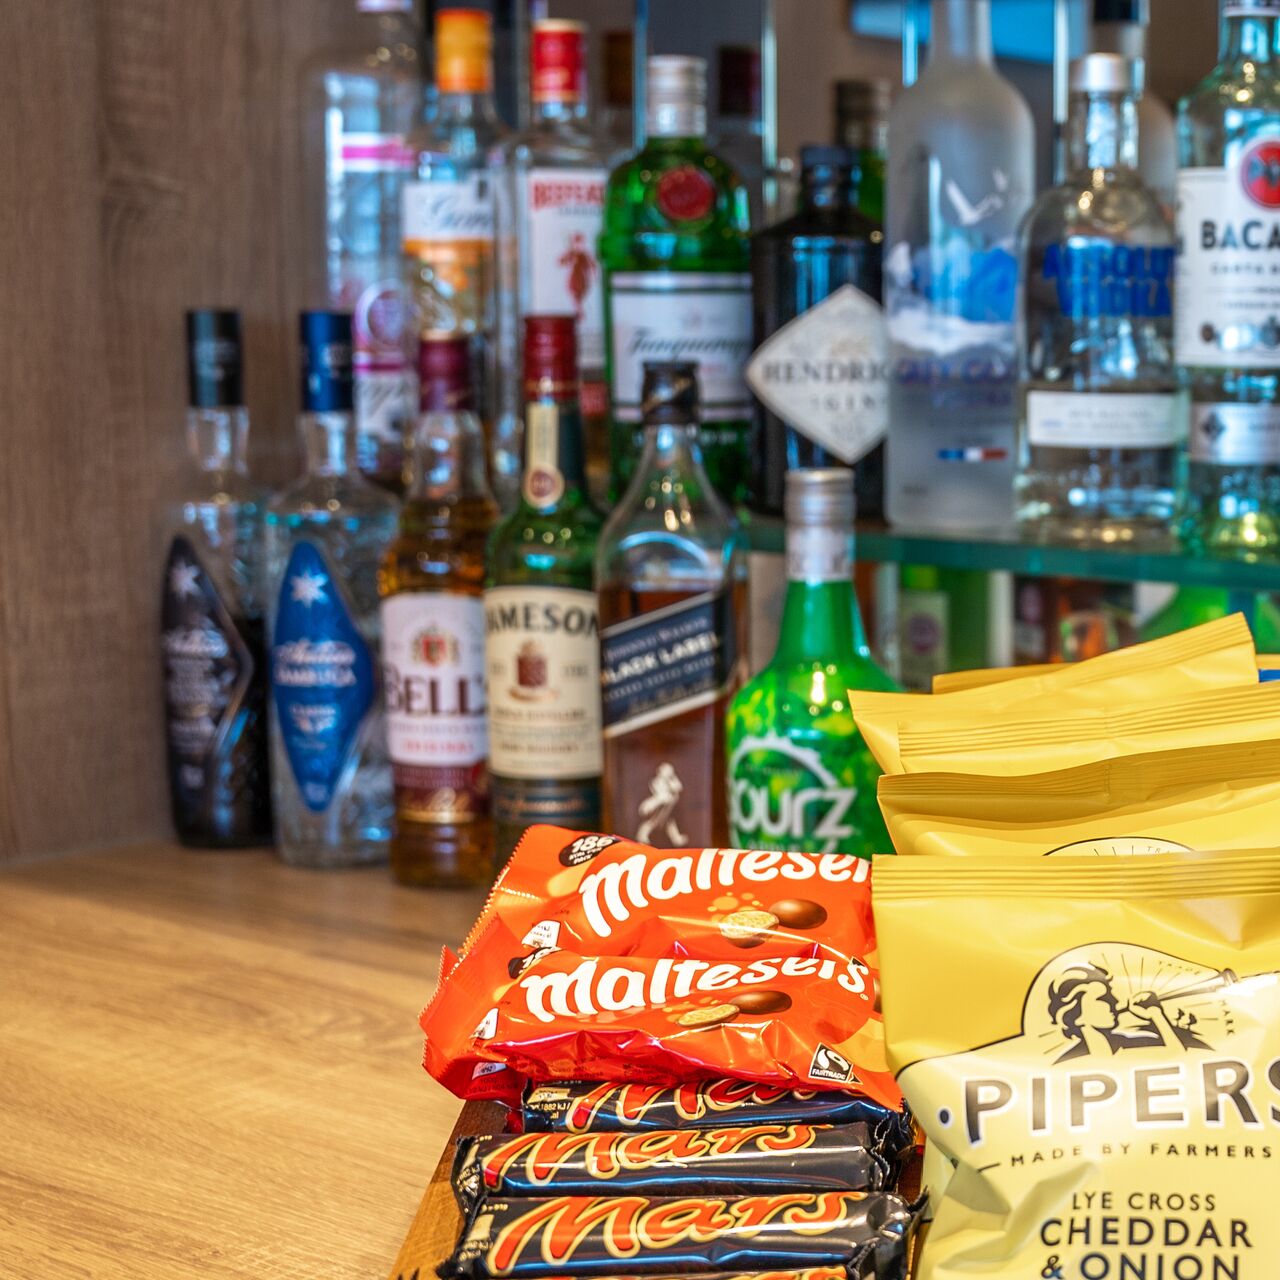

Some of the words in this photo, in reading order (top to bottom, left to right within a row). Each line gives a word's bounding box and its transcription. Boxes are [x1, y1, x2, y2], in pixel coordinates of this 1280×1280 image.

[533, 182, 604, 211] BEEFEA
[578, 848, 870, 938] Malteser
[811, 1068, 847, 1080] FAIRTRADE
[481, 1122, 835, 1191] Mars
[1010, 1145, 1084, 1168] MADE
[1101, 1143, 1132, 1156] BY
[1150, 1143, 1274, 1159] FARMERS
[1072, 1192, 1114, 1211] LYE
[1127, 1193, 1217, 1212] CROSS
[487, 1191, 866, 1276] Mars
[1040, 1218, 1252, 1248] CHEDDAR
[1040, 1254, 1065, 1280] &
